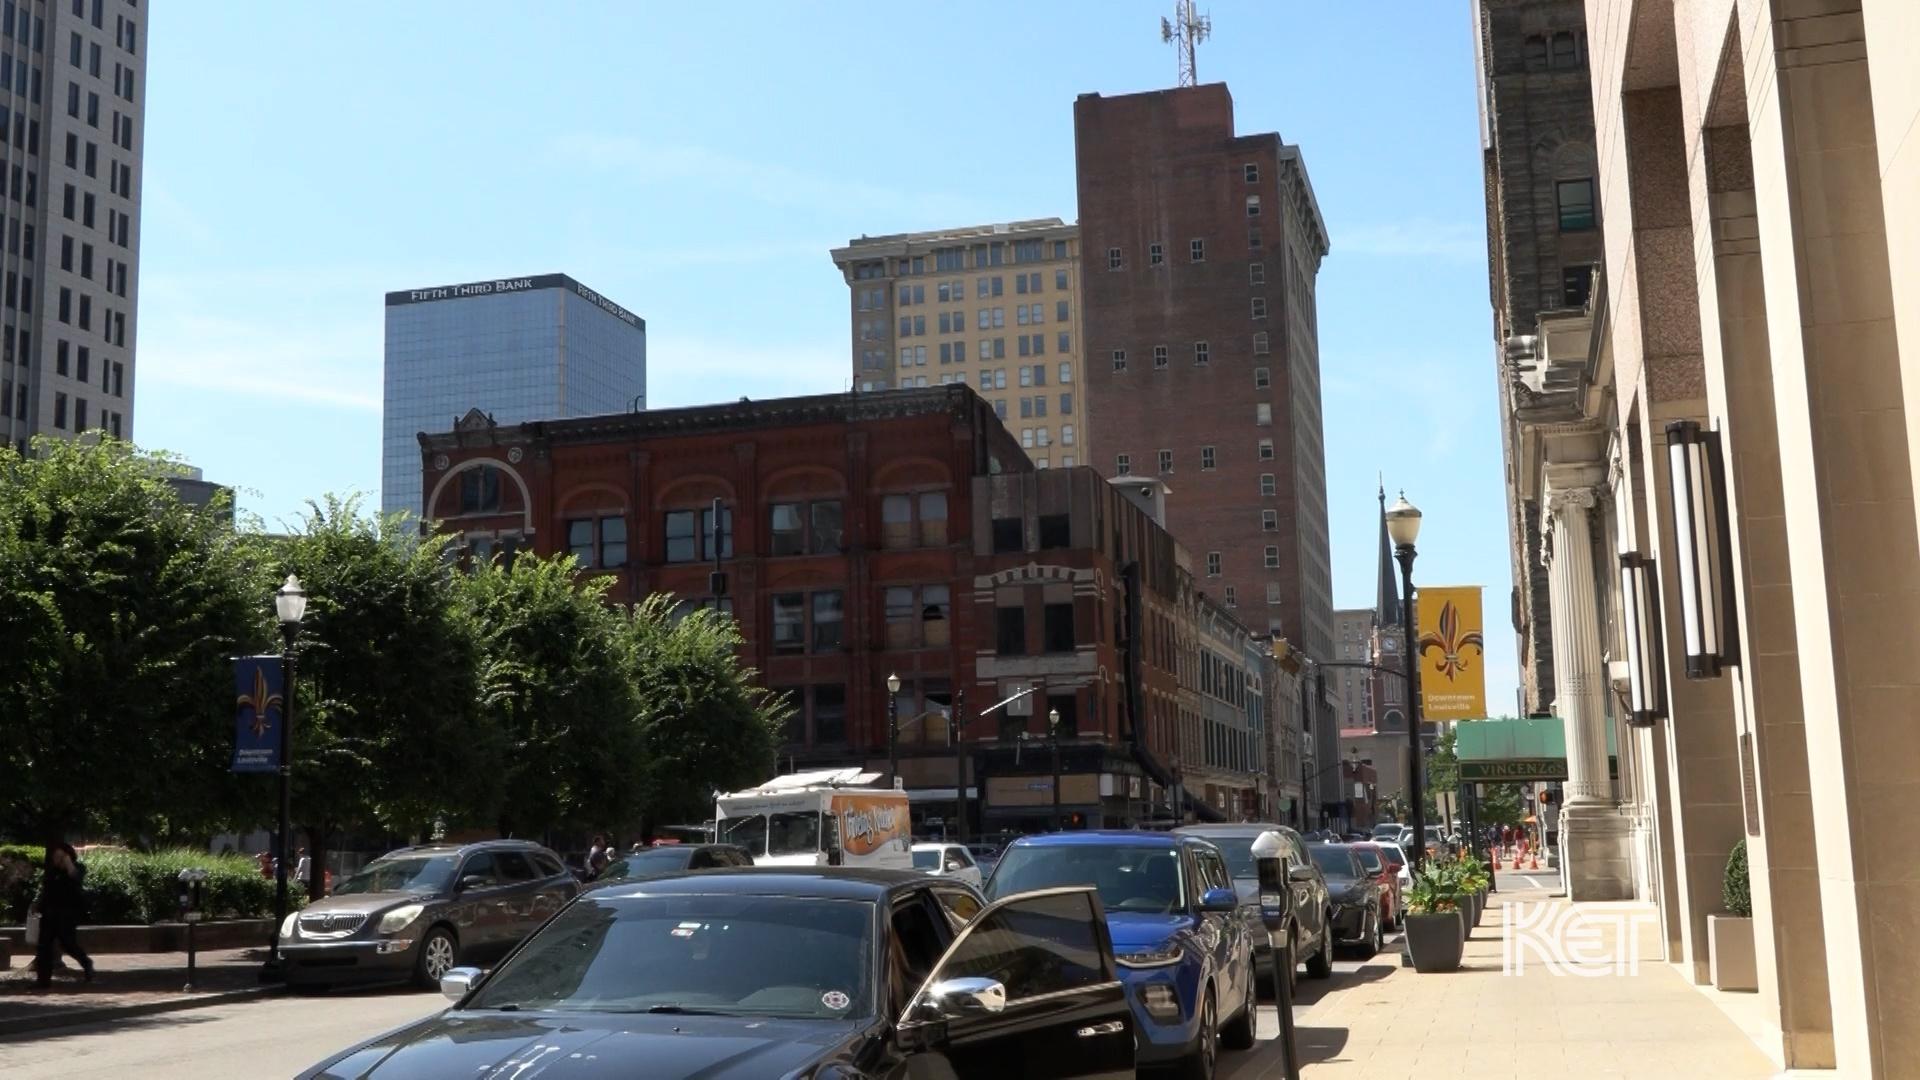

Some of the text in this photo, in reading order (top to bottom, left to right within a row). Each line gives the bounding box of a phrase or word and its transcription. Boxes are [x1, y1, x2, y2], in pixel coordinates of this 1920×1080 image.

[411, 279, 533, 301] FIFTH THIRD BANK
